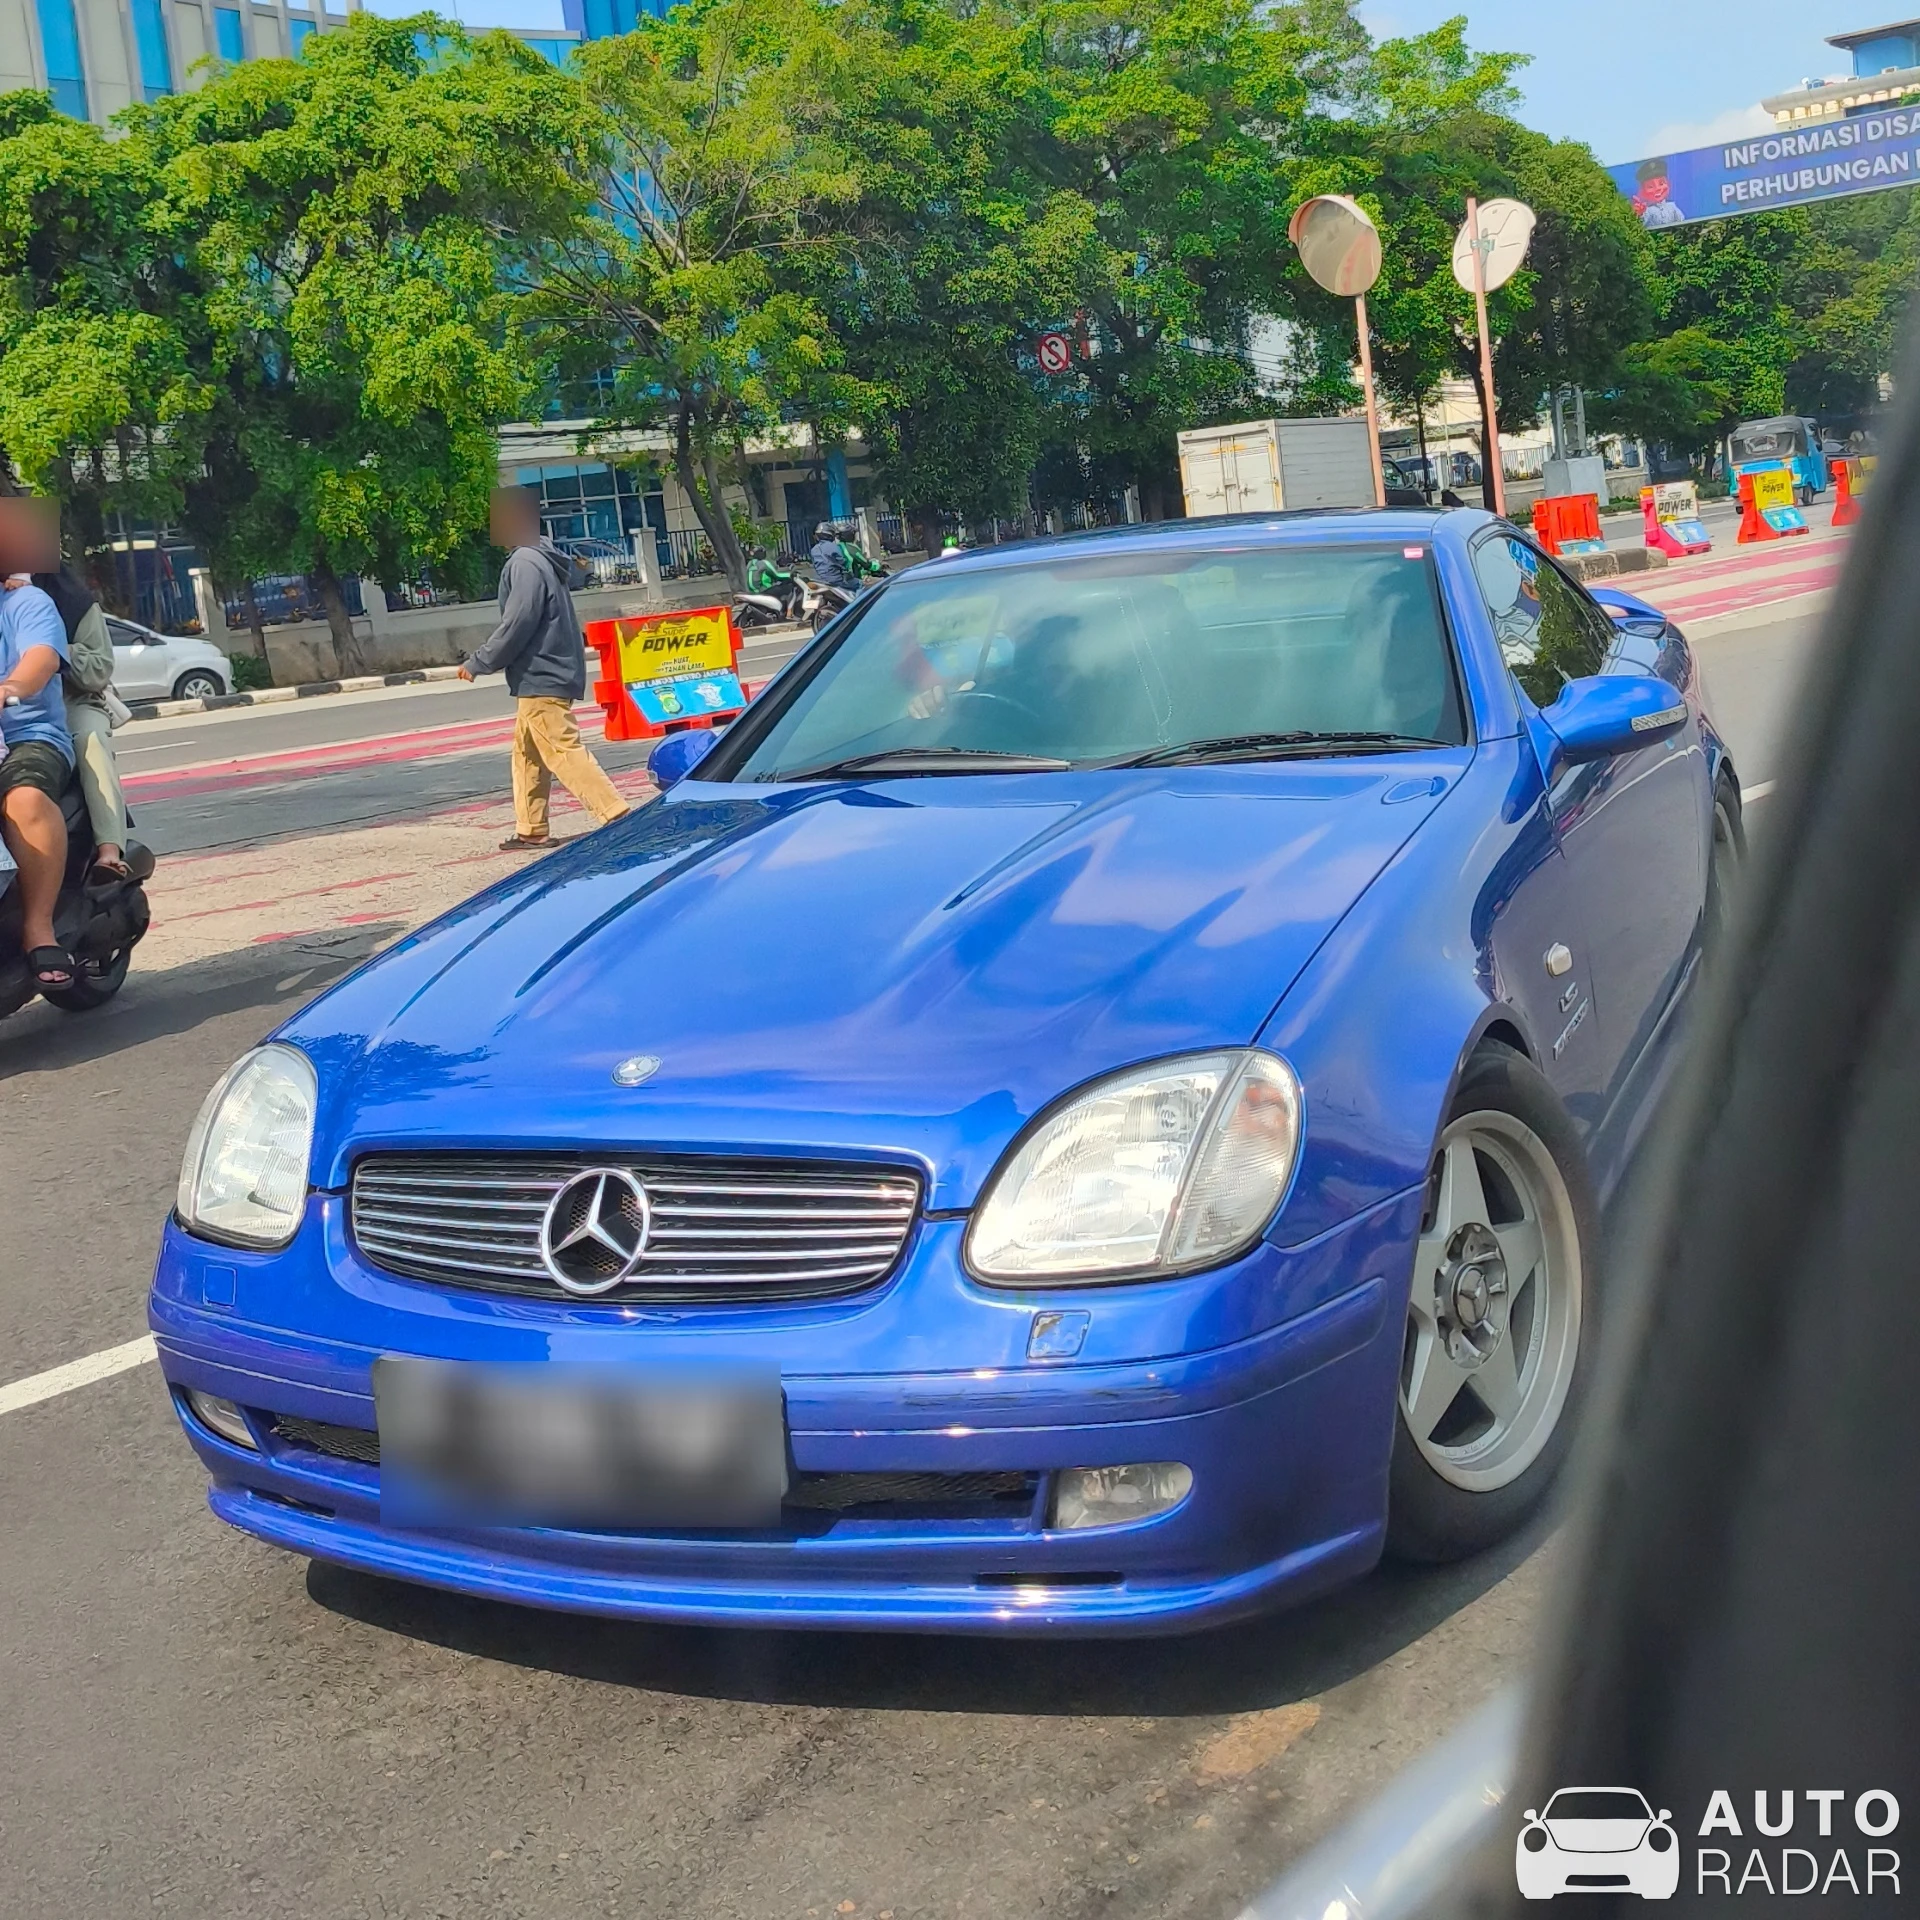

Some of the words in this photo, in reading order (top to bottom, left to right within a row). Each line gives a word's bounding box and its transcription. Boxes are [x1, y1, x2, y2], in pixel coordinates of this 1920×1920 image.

[1724, 123, 1861, 169] INFORMASI
[1721, 150, 1909, 204] PERHUBUNGAN
[1762, 482, 1785, 494] POWER
[1657, 499, 1692, 515] POWER
[641, 632, 709, 653] POWER
